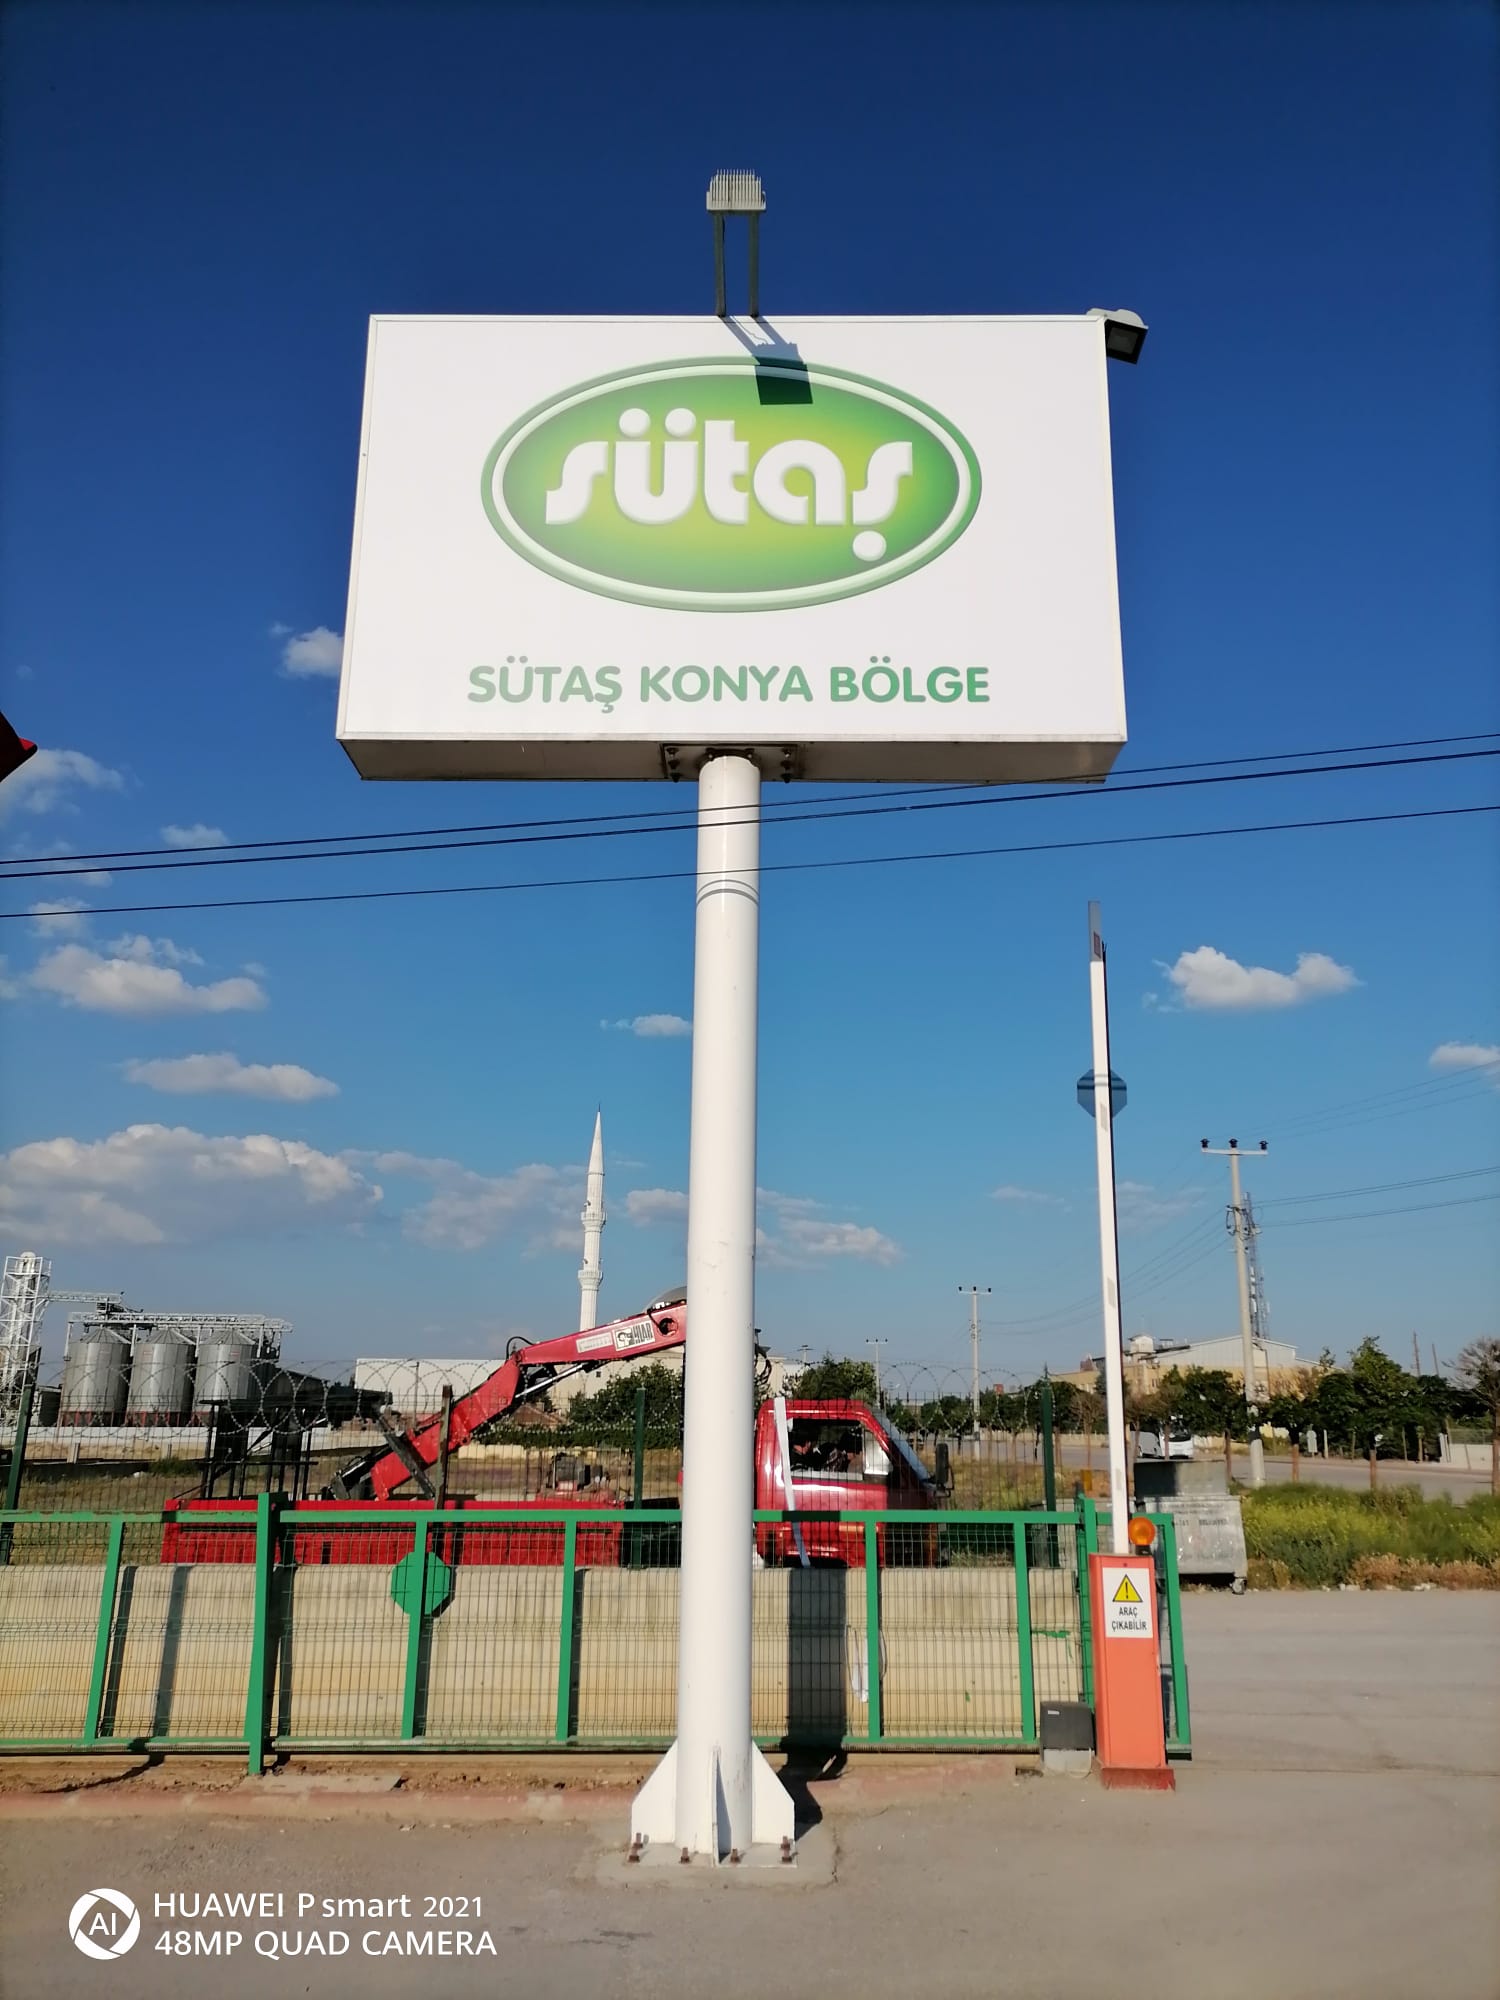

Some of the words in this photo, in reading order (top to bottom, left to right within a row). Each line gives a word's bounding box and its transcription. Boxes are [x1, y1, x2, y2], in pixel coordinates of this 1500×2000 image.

[545, 406, 913, 563] sütaş
[467, 655, 623, 714] SÜTAŞ
[640, 664, 814, 704] KONYA
[830, 655, 990, 704] BÖLGE
[1111, 1619, 1148, 1632] ÇIKABİLİR
[1119, 1606, 1138, 1618] ARAÇ
